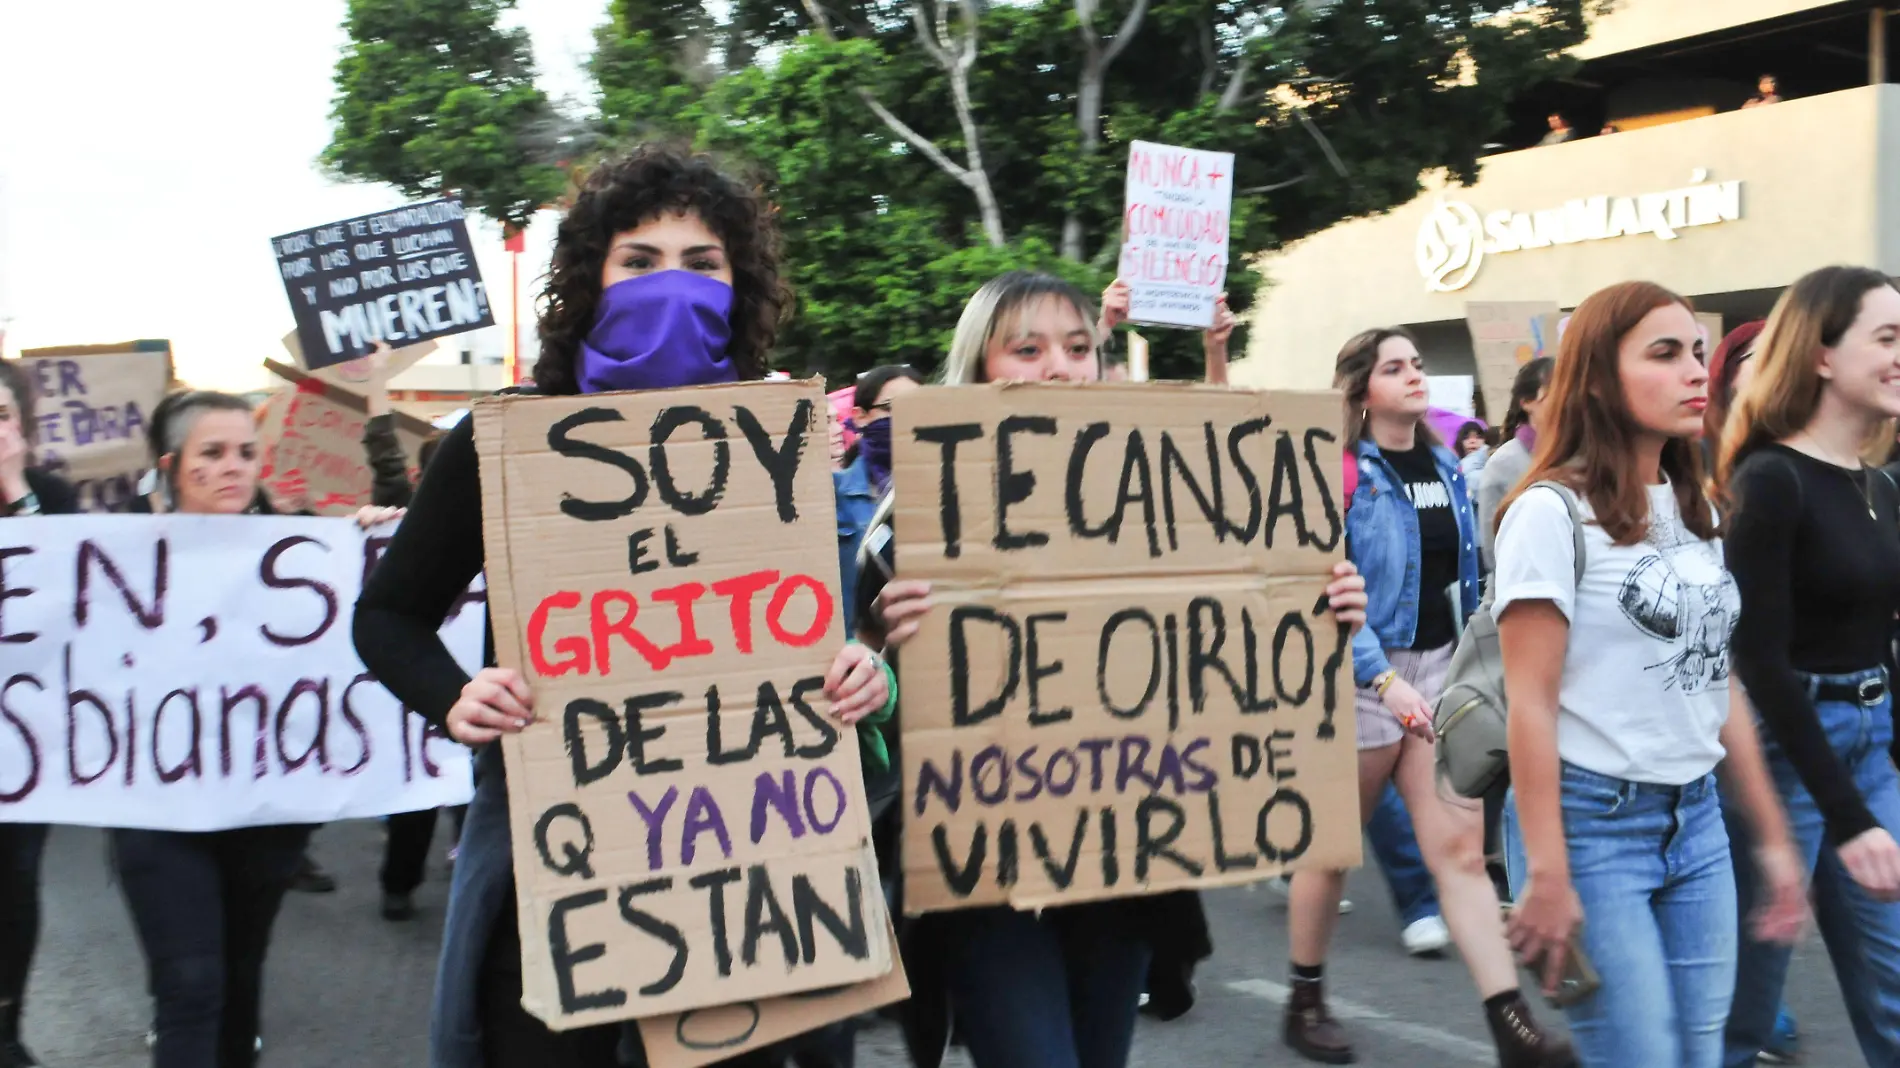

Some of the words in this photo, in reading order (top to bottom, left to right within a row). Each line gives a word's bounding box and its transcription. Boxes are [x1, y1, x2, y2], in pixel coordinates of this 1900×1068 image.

[1130, 151, 1199, 190] NUNCA
[301, 286, 317, 304] Y
[329, 277, 358, 298] NO
[360, 266, 397, 290] POR
[397, 260, 431, 282] LAS
[430, 252, 469, 275] QUE
[547, 399, 816, 522] SOY
[911, 415, 1058, 559] TE
[1064, 415, 1342, 558] CANSAS
[627, 523, 699, 575] EL
[527, 569, 834, 678] GRITO
[948, 604, 1074, 728] DE
[1096, 594, 1352, 740] OIRLO?
[563, 691, 684, 787] DE
[704, 675, 842, 765] LAS
[914, 735, 1218, 816] NOSOTRAS
[1230, 729, 1296, 784] DE
[533, 802, 595, 880] Q
[627, 784, 733, 870] YA
[749, 766, 847, 845] NO
[930, 787, 1313, 897] VIVIRLO
[548, 863, 872, 1015] ESTAN
